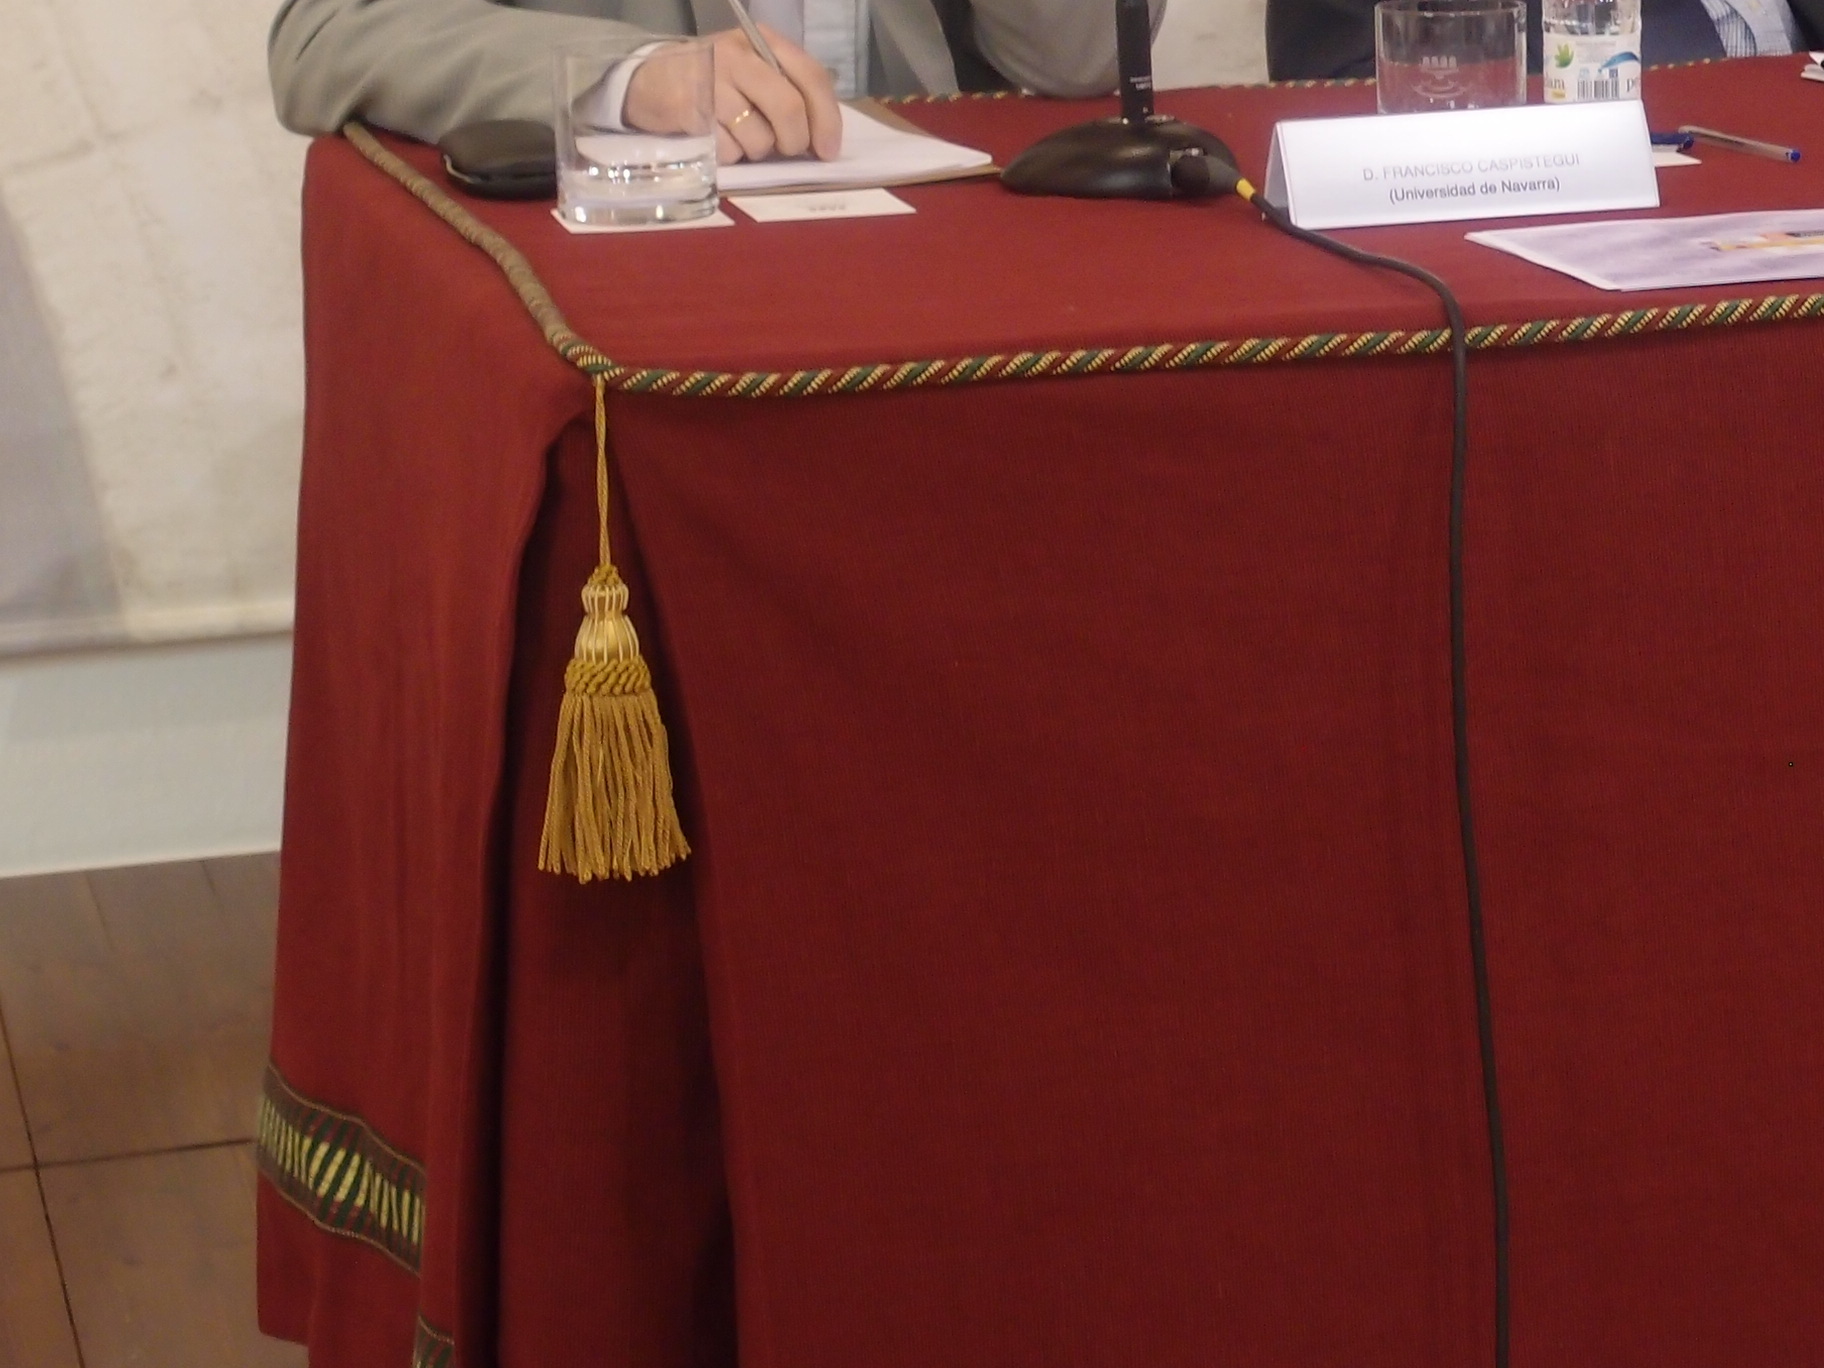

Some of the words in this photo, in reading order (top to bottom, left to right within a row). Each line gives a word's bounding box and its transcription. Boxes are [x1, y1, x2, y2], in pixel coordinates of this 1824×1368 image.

[1363, 167, 1379, 182] D.
[1383, 161, 1473, 180] FRANCISCO
[1477, 153, 1580, 173] CASPISTEGUI
[1389, 182, 1476, 205] (Universidad
[1479, 181, 1497, 195] de
[1501, 176, 1561, 194] Navarra)
